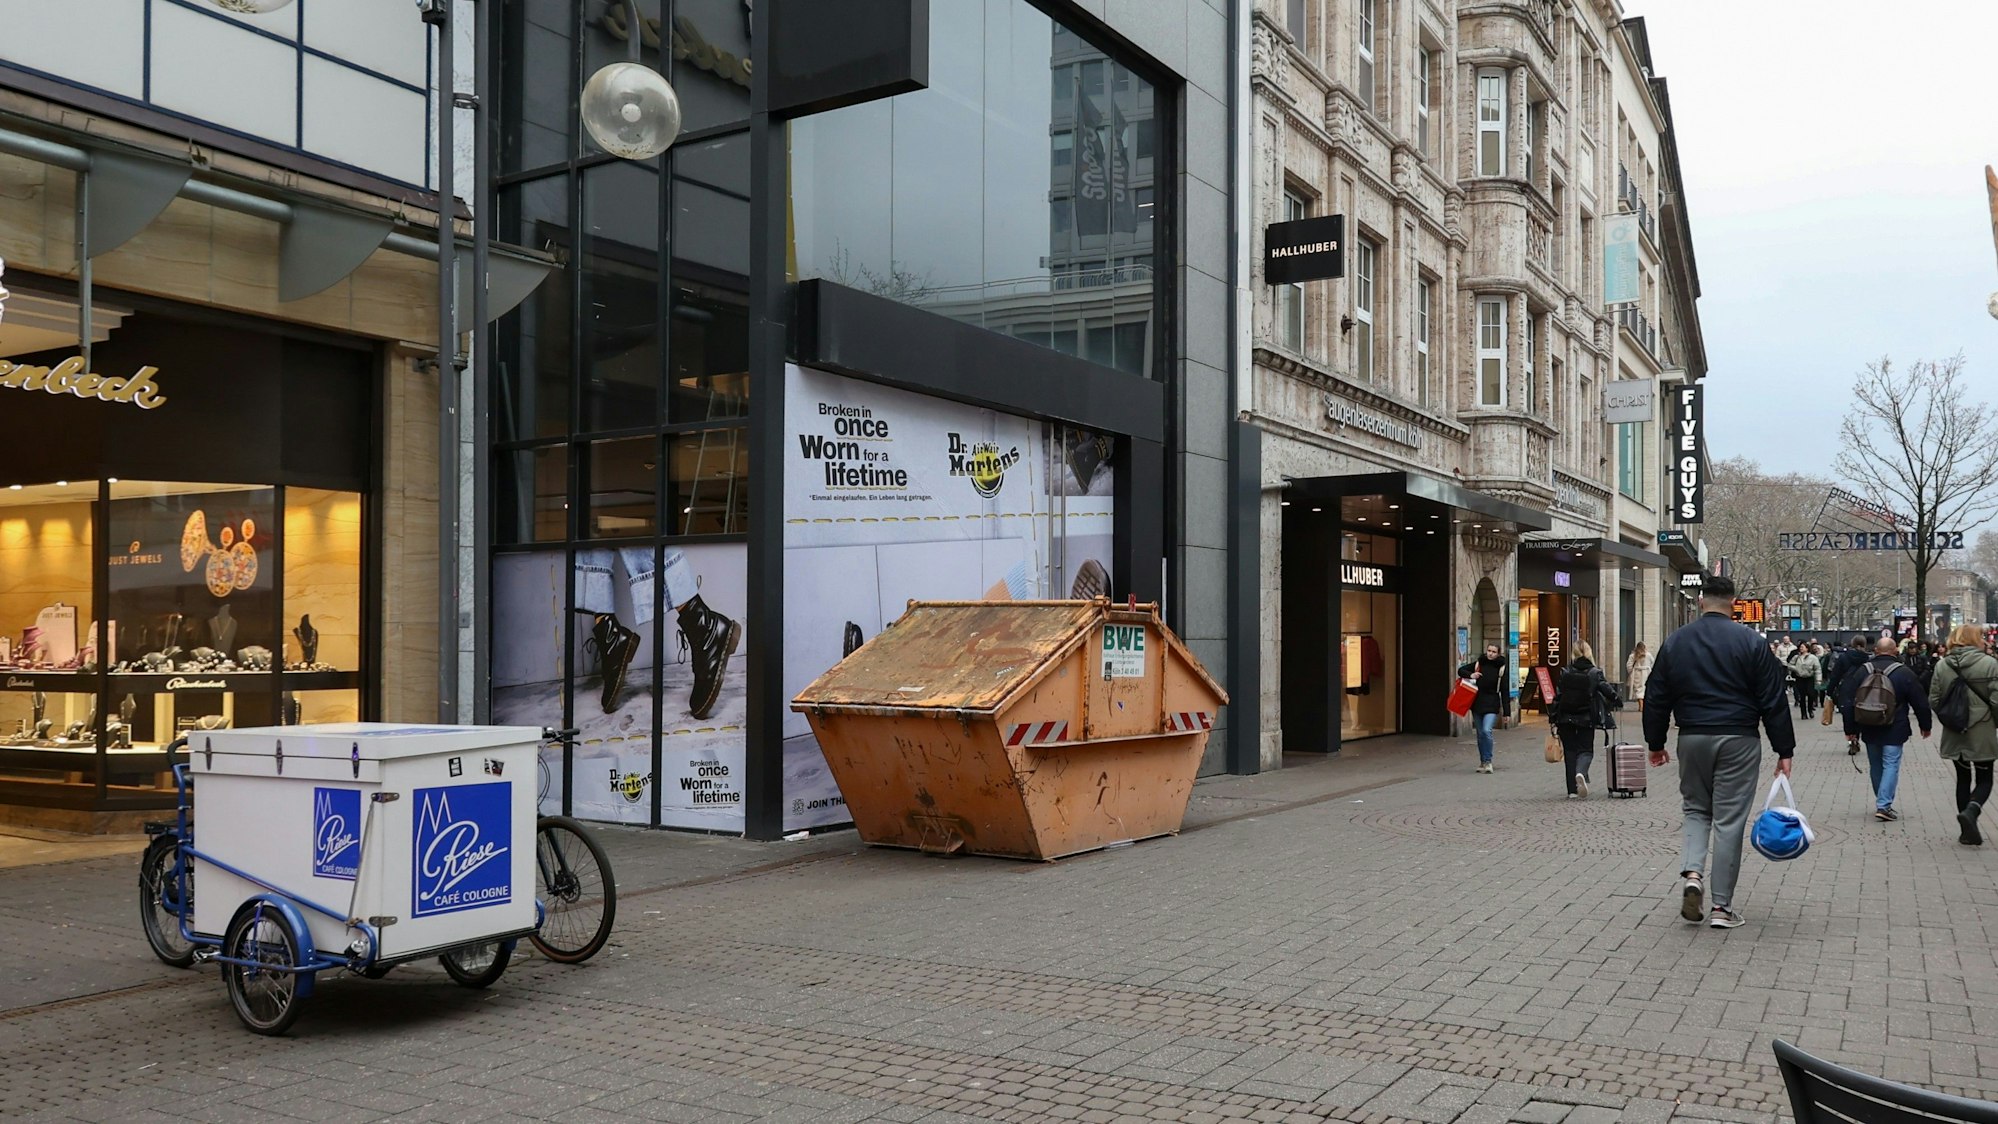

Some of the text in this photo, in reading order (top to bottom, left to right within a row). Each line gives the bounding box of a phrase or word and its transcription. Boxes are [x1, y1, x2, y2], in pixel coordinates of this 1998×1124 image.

[1272, 240, 1338, 259] HALLHUBER
[818, 403, 872, 418] Broken in
[1608, 394, 1649, 409] CHRIST
[834, 417, 889, 438] once
[1329, 400, 1424, 449] augenlaserzentrum köln
[799, 434, 889, 462] Worn for a
[947, 432, 968, 454] Dr.
[948, 446, 1020, 476] Martens
[1680, 390, 1698, 519] FIVE GUYS
[825, 462, 908, 487] lifetime
[1525, 541, 1560, 549] TRAURING
[109, 553, 162, 566] JUST JEWELS
[1103, 625, 1144, 651] BWE
[1547, 626, 1560, 667] CHRIST
[698, 765, 729, 776] once
[610, 772, 653, 792] Martens
[679, 777, 712, 790] Worn
[807, 798, 828, 809] JOIN
[317, 814, 359, 866] Riese
[322, 864, 335, 873] CAFÉ
[420, 820, 508, 900] Riese
[433, 885, 509, 907] CAFÉ COLOGNE
